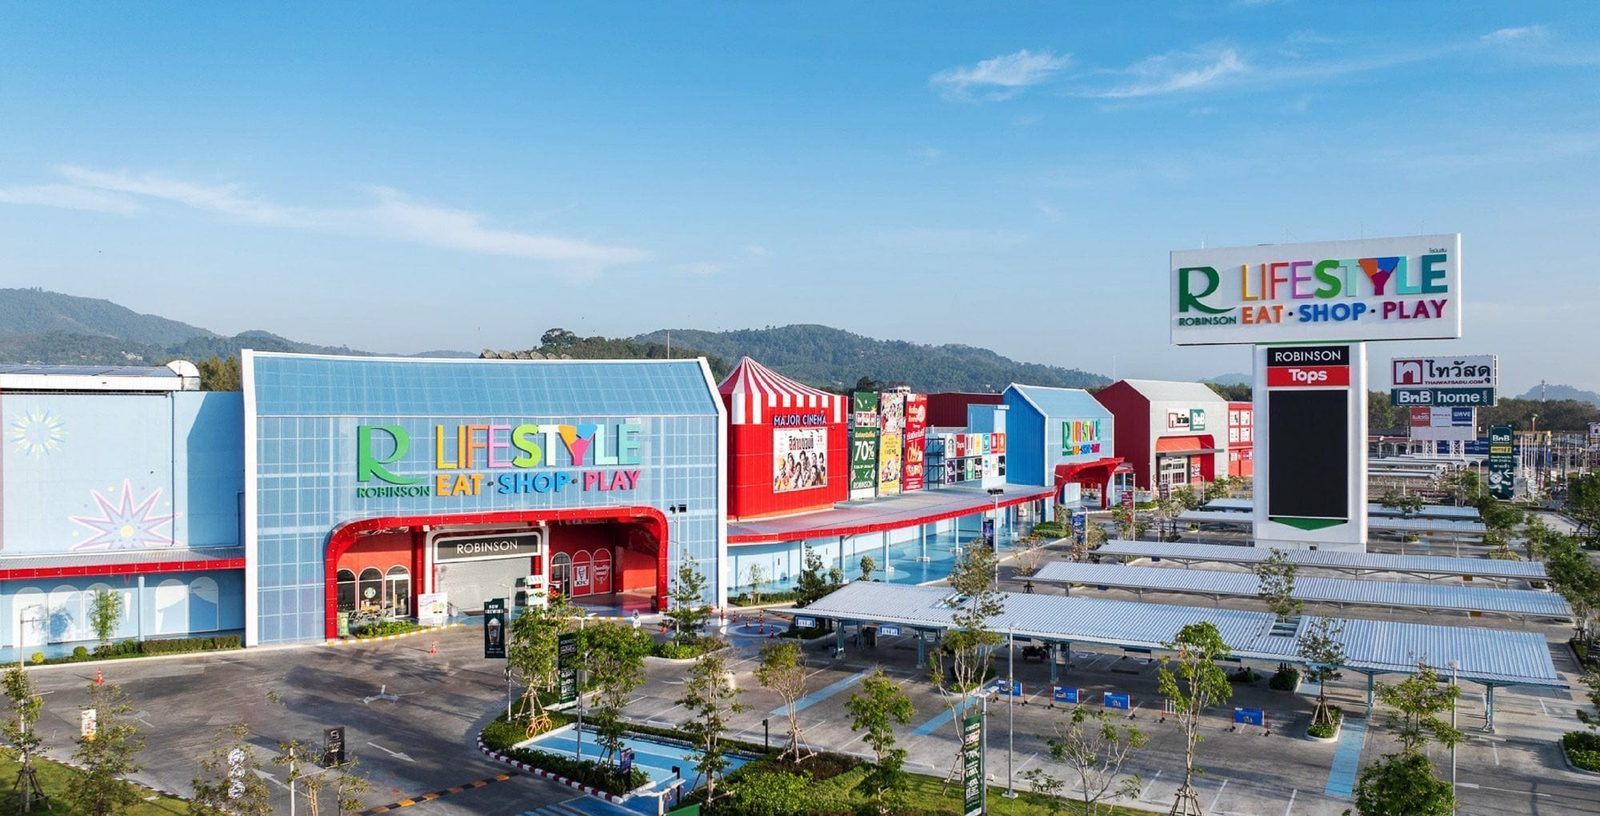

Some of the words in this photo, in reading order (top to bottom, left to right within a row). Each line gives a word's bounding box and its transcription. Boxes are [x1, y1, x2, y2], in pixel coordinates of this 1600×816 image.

[1241, 254, 1448, 301] LIFESTYLE
[1242, 305, 1283, 325] EAT
[1298, 301, 1367, 322] SHOP
[1383, 299, 1448, 319] PLAY
[1179, 316, 1236, 326] ROBINSON
[1275, 350, 1341, 362] ROBINSON
[1288, 369, 1328, 383] Tops
[1425, 360, 1491, 384] ไทวัสดุ
[1400, 391, 1431, 403] BnB
[1438, 391, 1480, 403] home
[773, 414, 800, 426] MAJOR
[802, 414, 827, 425] CINEMA
[435, 424, 641, 469] LIFESTYLE
[435, 474, 485, 496] EAT
[498, 472, 570, 494] SHOP
[583, 470, 640, 491] PLAY
[356, 486, 430, 498] ROBINSON
[456, 540, 518, 554] ROBINSON
